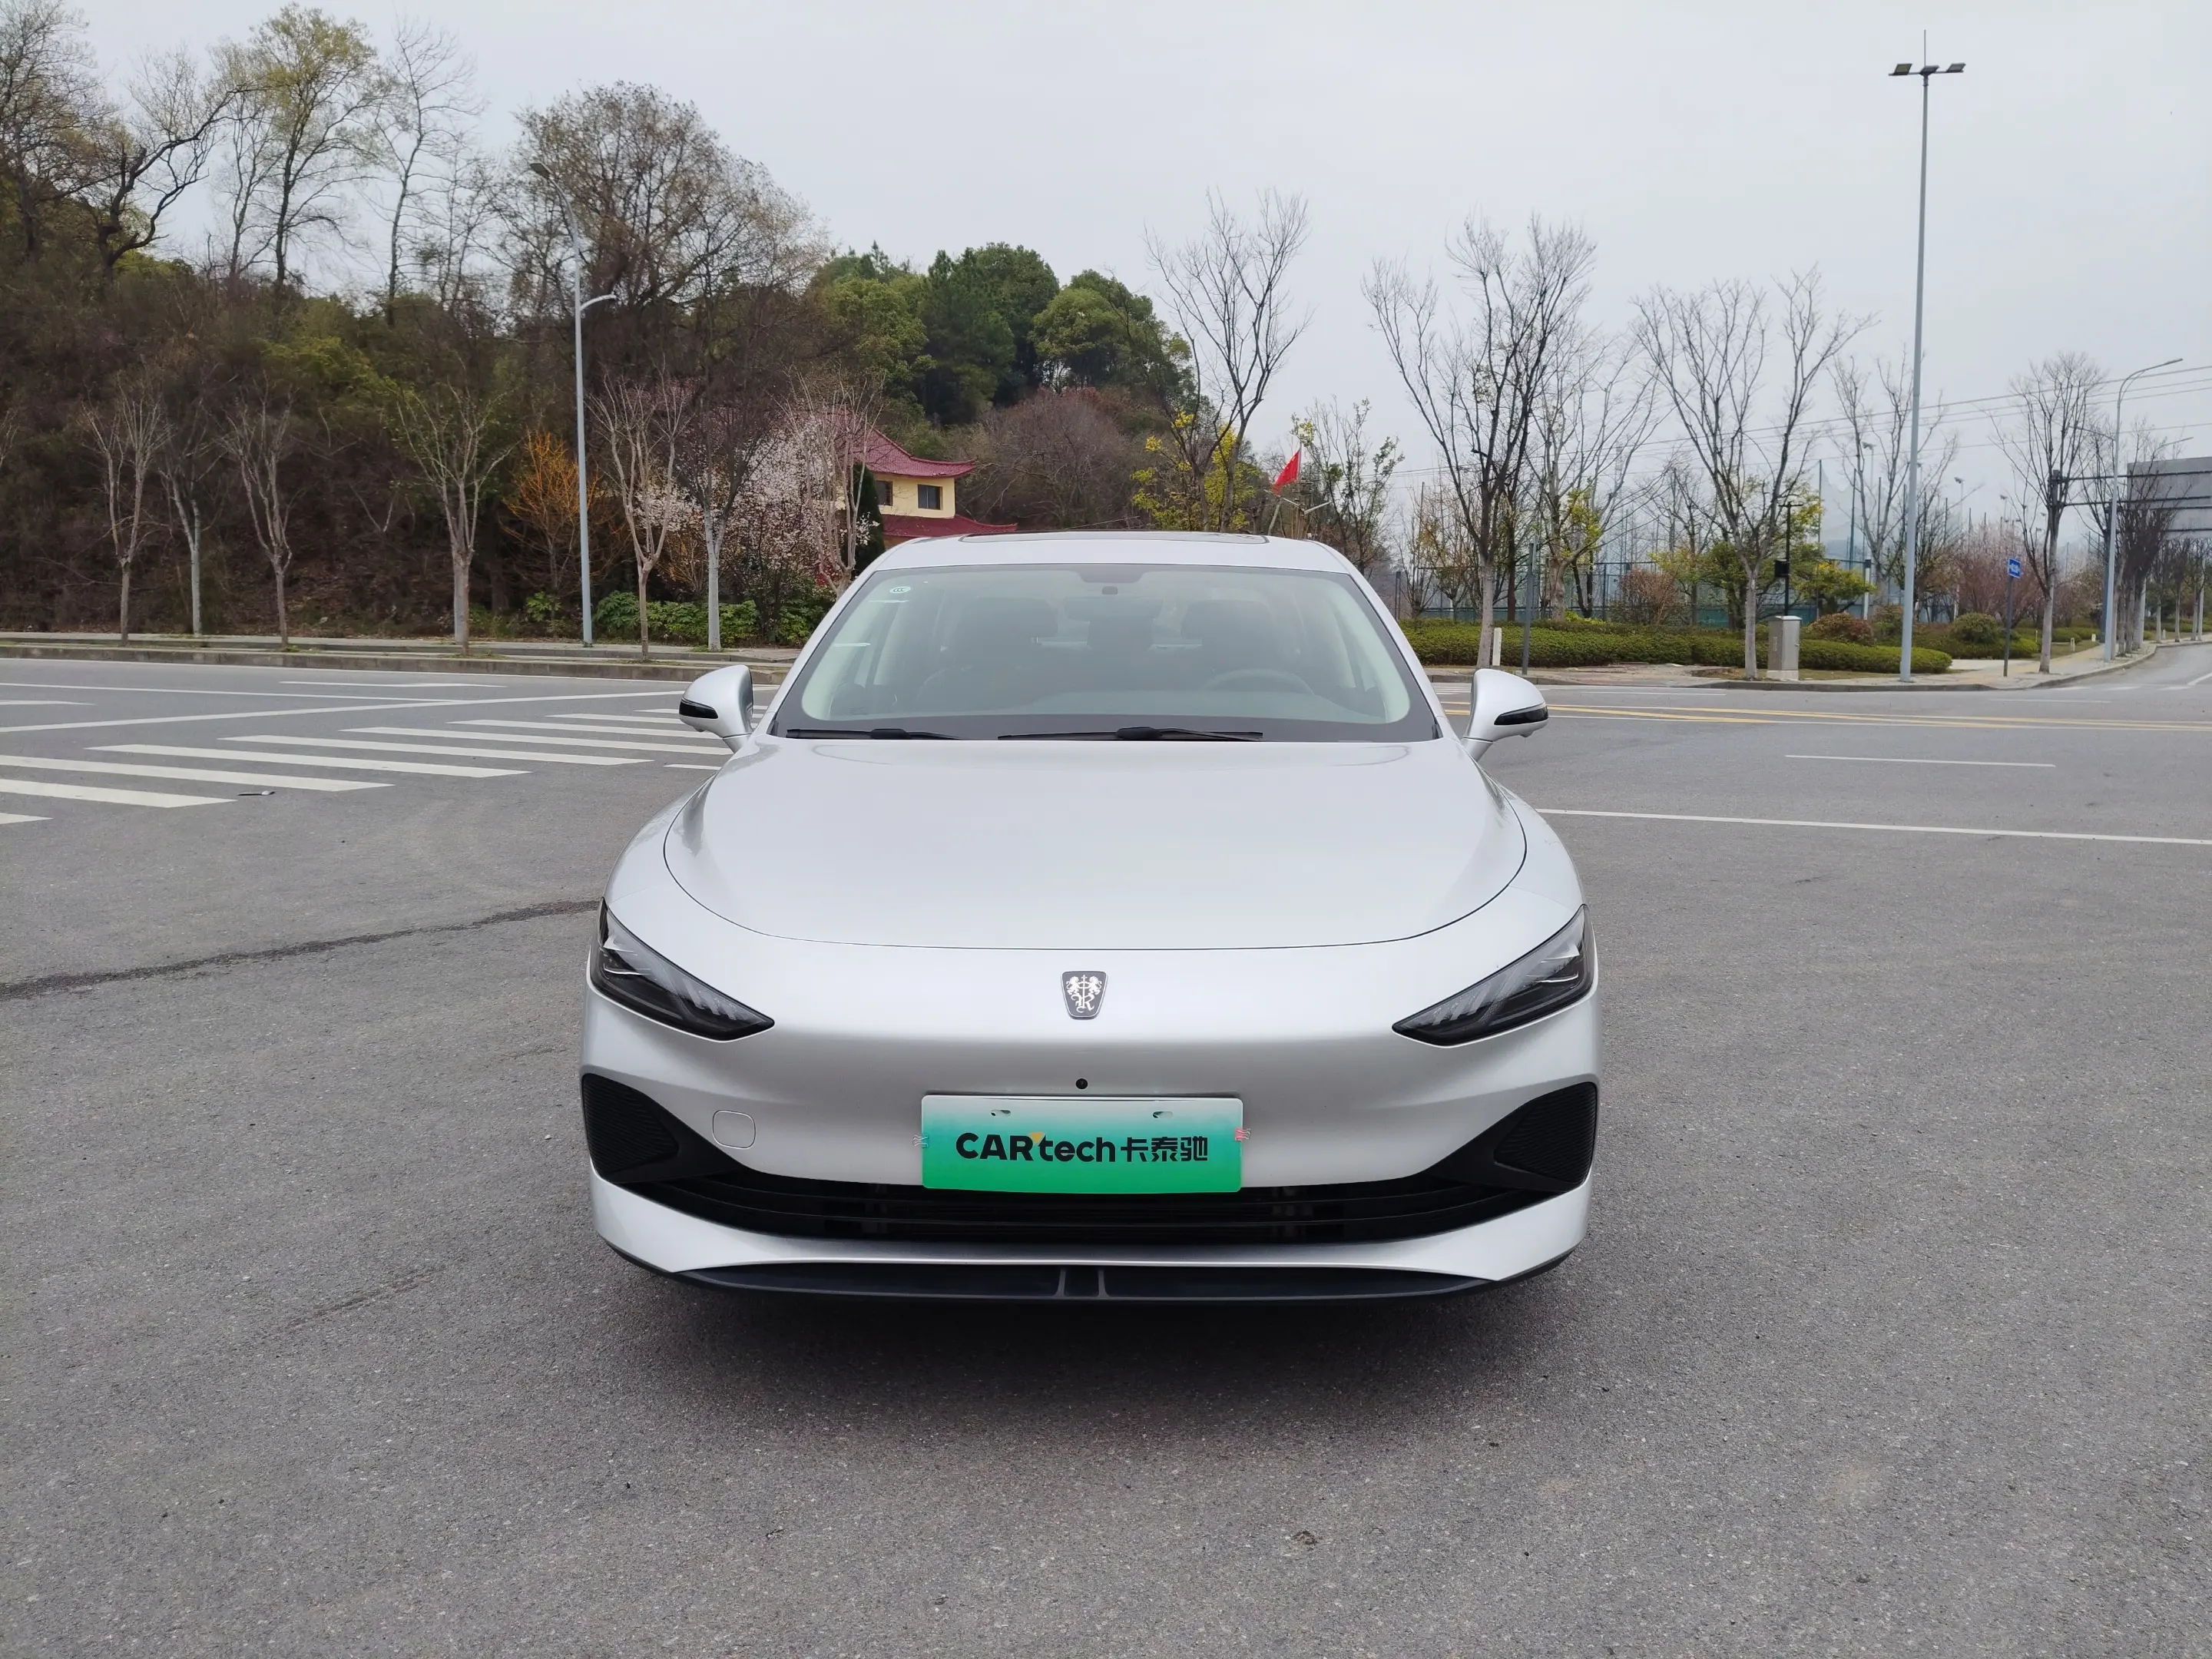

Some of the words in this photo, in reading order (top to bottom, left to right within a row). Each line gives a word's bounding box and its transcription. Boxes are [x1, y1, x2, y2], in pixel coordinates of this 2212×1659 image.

[955, 1132, 1116, 1163] CARtech
[1120, 1135, 1208, 1163] 卡泰驰
